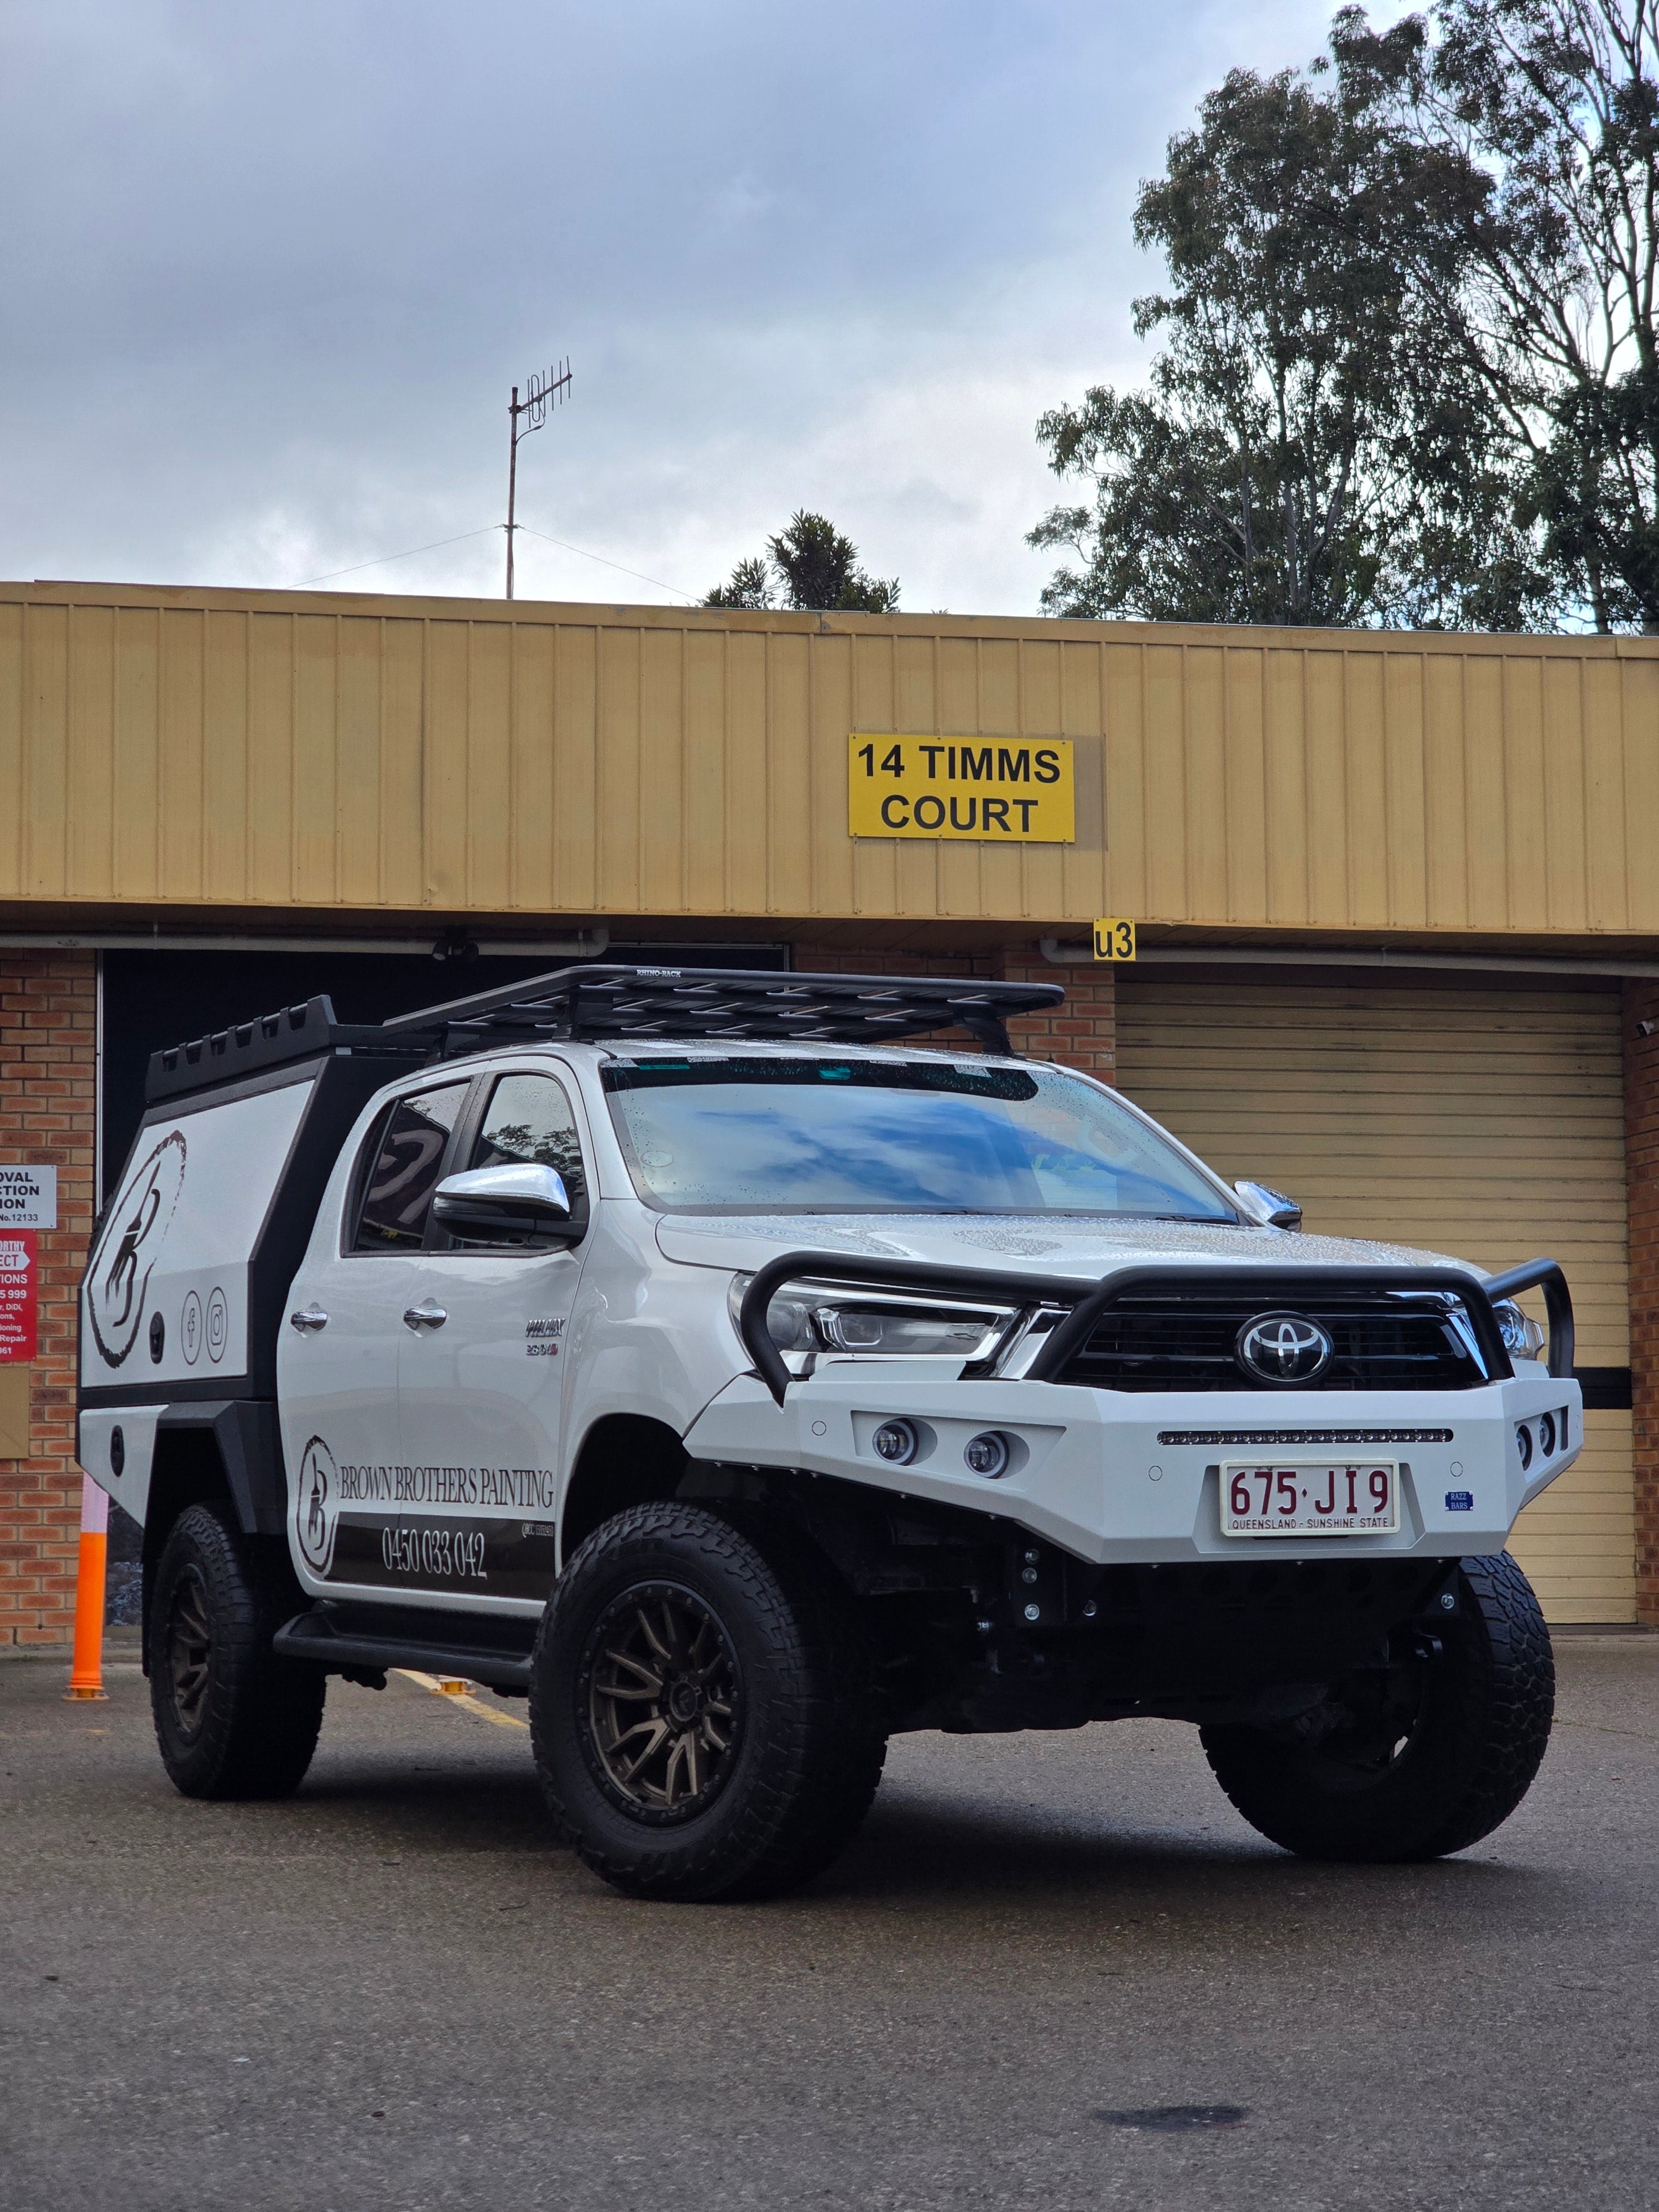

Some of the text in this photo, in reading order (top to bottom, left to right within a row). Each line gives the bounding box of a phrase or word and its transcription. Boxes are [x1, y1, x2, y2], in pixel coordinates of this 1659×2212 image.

[858, 743, 1061, 784] 14 TIMMS
[880, 794, 1039, 833] COURT
[1095, 922, 1133, 958] u3
[636, 969, 681, 978] RHINO-RACK
[0, 1185, 39, 1196] TION
[0, 1274, 28, 1284] IONS
[8, 1290, 27, 1298] 999
[0, 1334, 27, 1344] Repair
[340, 1466, 554, 1508] BROWN BROTHERS PAINTING
[1232, 1519, 1297, 1530] QUEENSLAND
[1307, 1517, 1355, 1528] SUNSHINE
[1359, 1517, 1389, 1527] STATE
[382, 1527, 488, 1580] 0450 033 042
